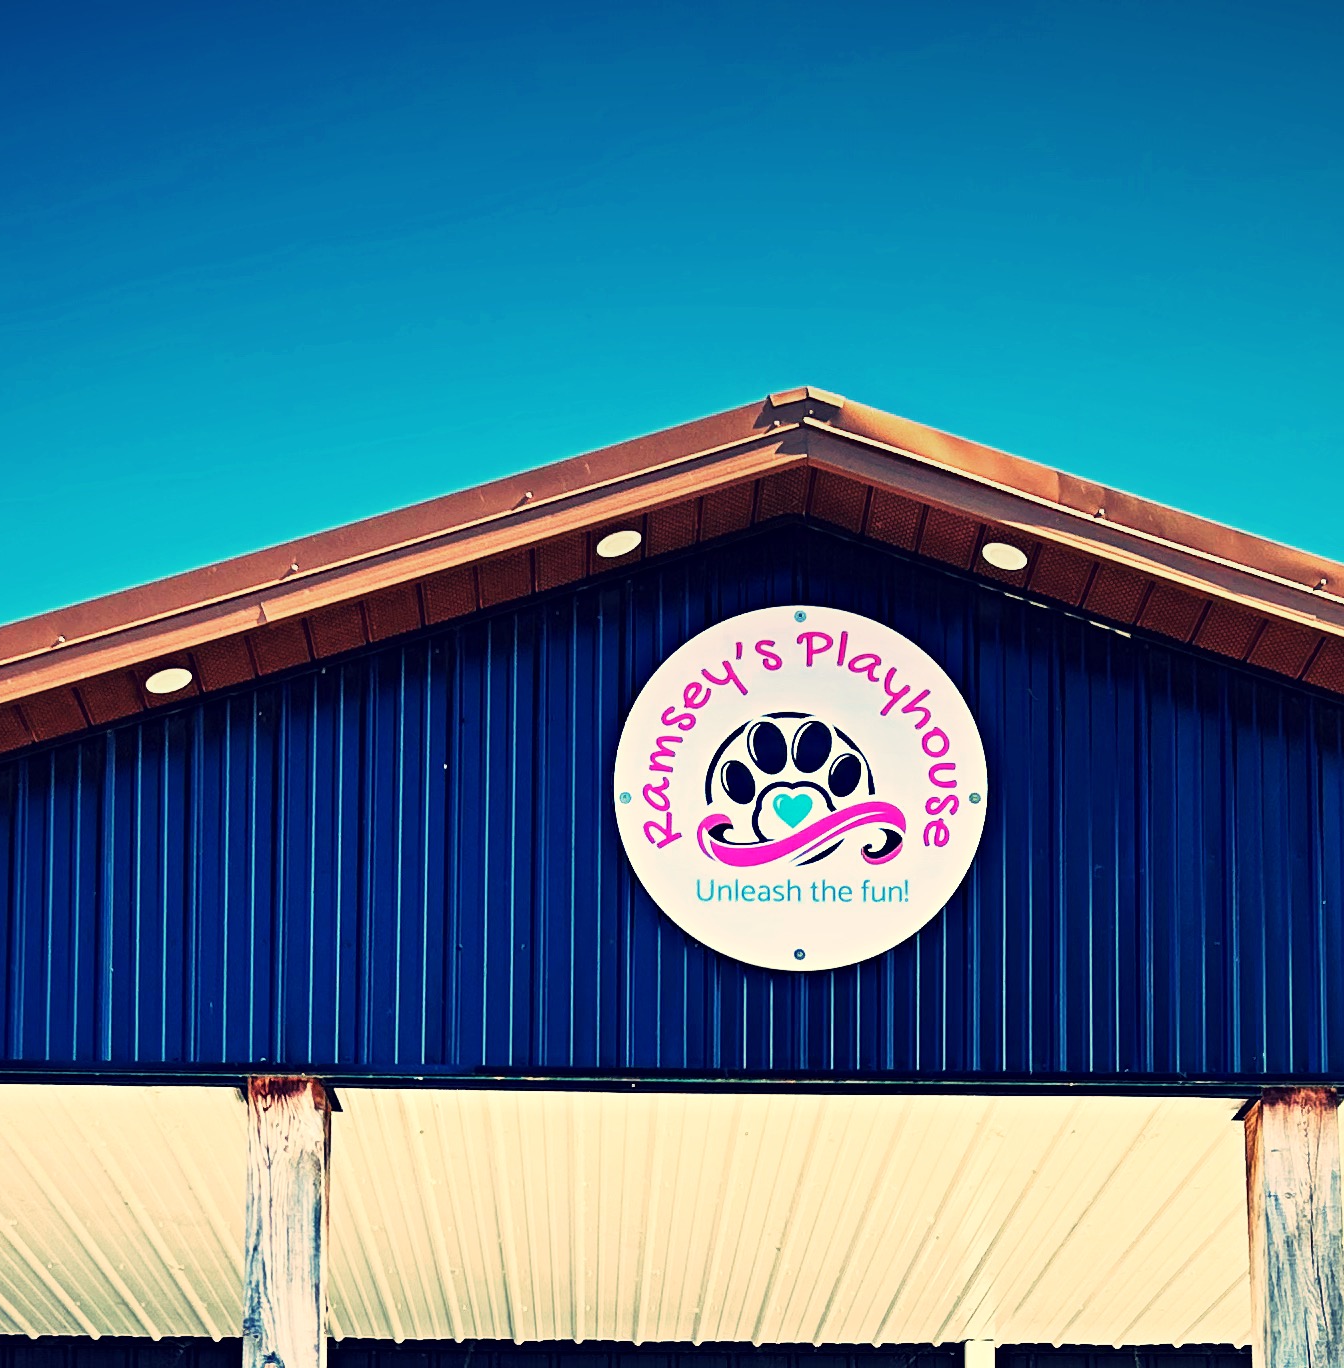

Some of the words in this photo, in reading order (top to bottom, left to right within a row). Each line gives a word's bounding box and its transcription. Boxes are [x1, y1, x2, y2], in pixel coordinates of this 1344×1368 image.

[642, 639, 783, 849] Ramsey's
[796, 631, 960, 849] Playhouse
[696, 878, 803, 903] Unleash
[810, 879, 853, 903] the
[861, 879, 910, 903] fun!
